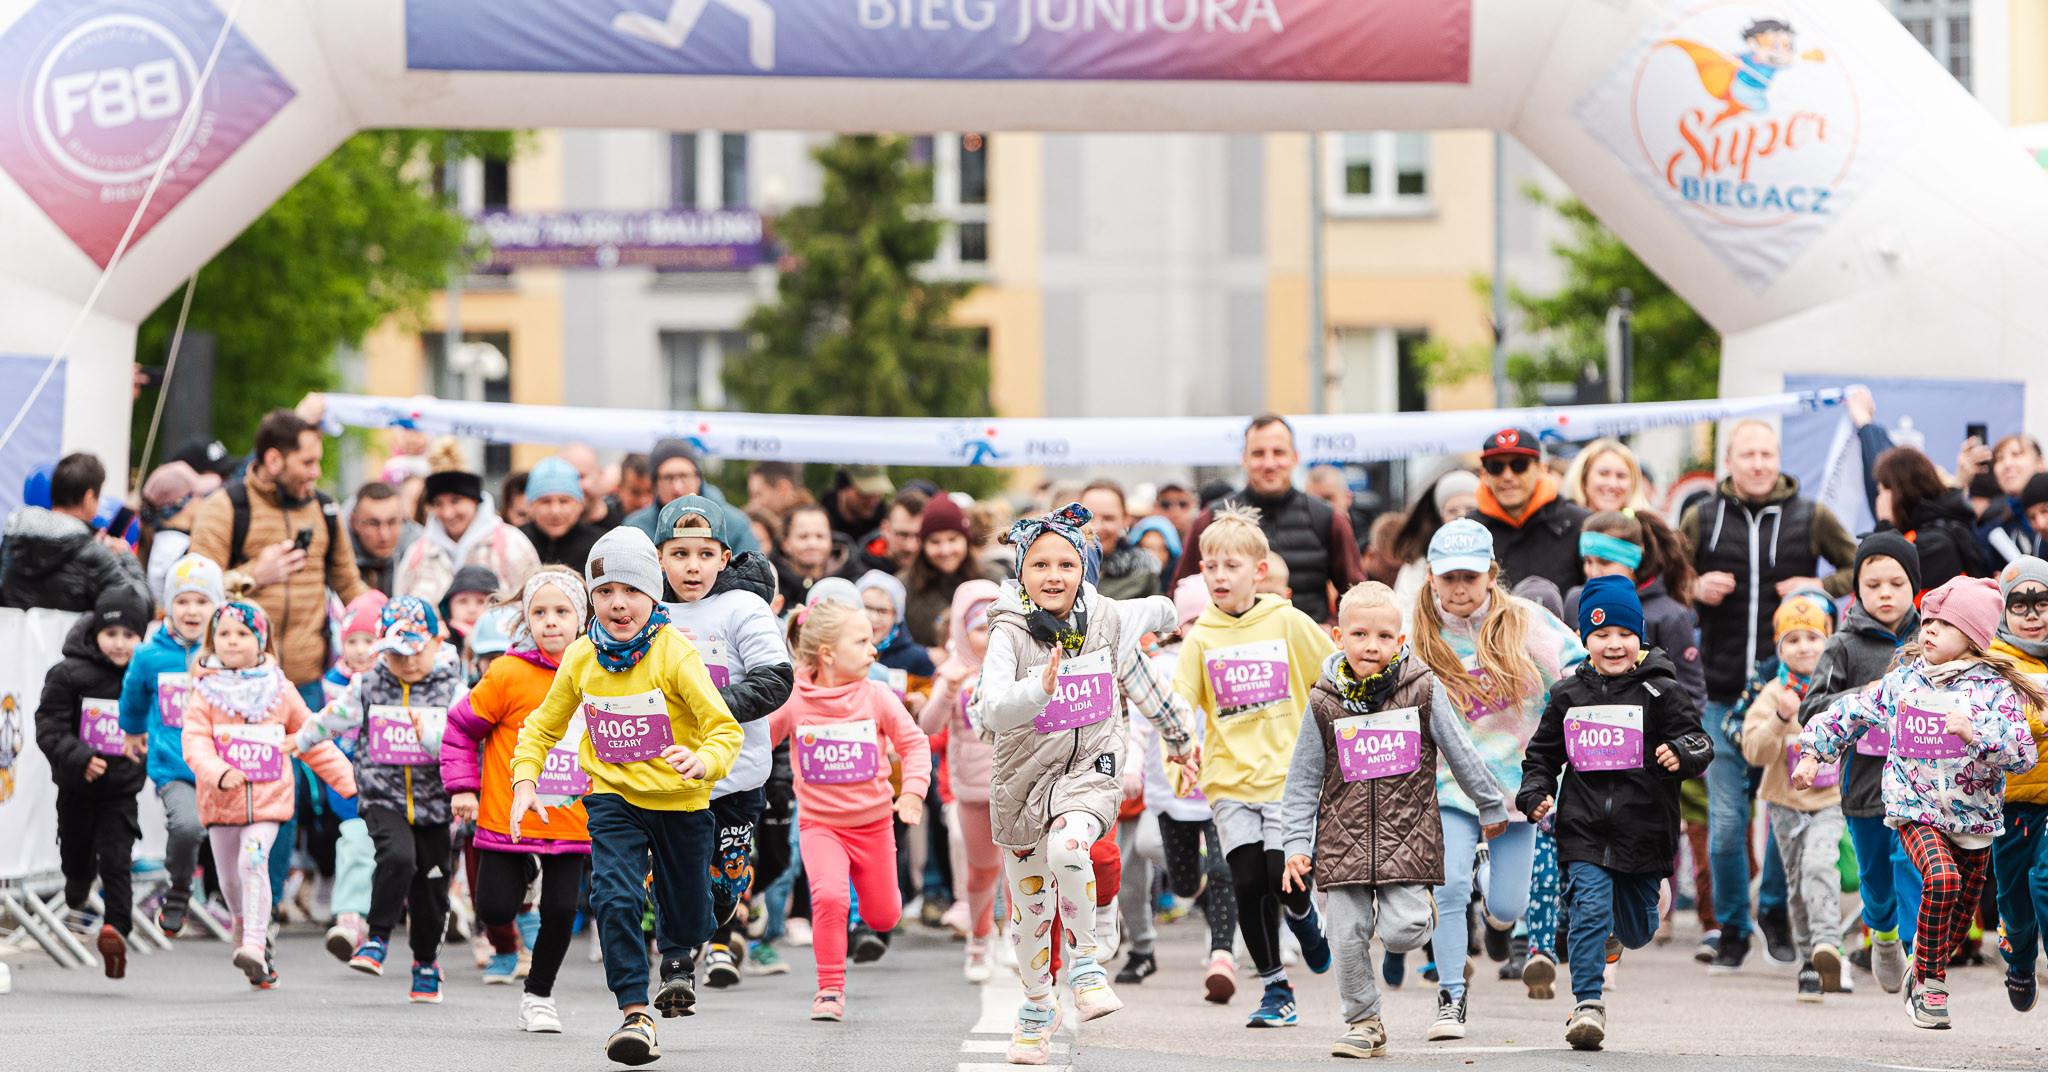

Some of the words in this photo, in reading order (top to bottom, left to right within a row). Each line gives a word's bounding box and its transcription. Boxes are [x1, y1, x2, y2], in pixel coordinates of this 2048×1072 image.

[857, 0, 995, 32] BIEG
[1014, 0, 1285, 45] JUNIORA
[1681, 176, 1832, 214] BIEGACZ
[1224, 662, 1274, 684] 4023
[1051, 675, 1101, 705] 4041
[1069, 700, 1093, 713] LIDIA
[382, 725, 418, 745] 406
[597, 717, 650, 739] 4065
[1578, 727, 1625, 748] 4003
[608, 738, 642, 748] CEZARY
[1354, 731, 1407, 756] 4044
[1913, 735, 1944, 745] OLIWIA
[227, 743, 273, 763] 4070
[813, 742, 864, 763] 4054
[1367, 751, 1397, 765] ANTOŚ
[545, 753, 579, 773] 051
[541, 771, 573, 782] HANNA
